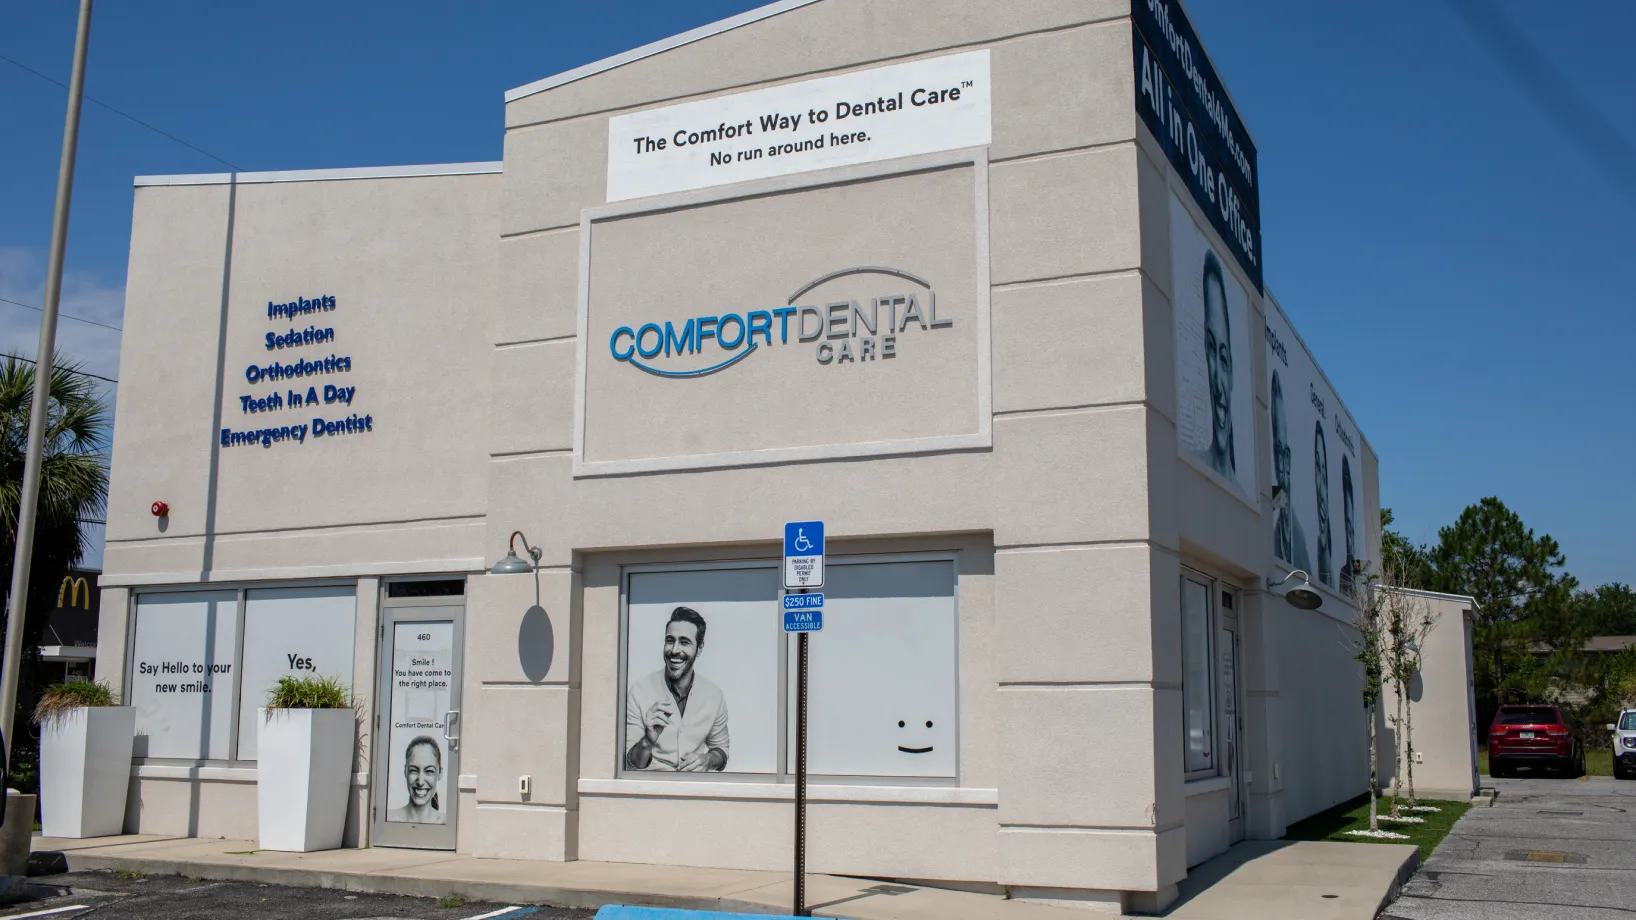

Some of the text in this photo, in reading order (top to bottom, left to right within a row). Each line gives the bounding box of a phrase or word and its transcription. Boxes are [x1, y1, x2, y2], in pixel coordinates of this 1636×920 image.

[633, 136, 667, 154] The
[673, 119, 753, 147] Comfort
[759, 111, 801, 134] Way
[808, 108, 829, 124] to
[836, 92, 903, 120] Dental
[710, 129, 871, 167] No run around here.
[1141, 45, 1257, 266] All in One Office.
[267, 294, 336, 319] Implants
[265, 325, 334, 349] Sedation
[816, 334, 896, 363] CARE
[245, 353, 351, 381] Orthodontics
[239, 384, 355, 412] Teeth In A Day
[220, 413, 373, 445] Emergency Dentist
[785, 596, 822, 608] $250 FINE
[785, 621, 821, 630] ACCESSIBLE
[794, 612, 812, 622] VAN
[417, 633, 431, 641] 460
[139, 661, 231, 677] Say Hello to your
[287, 653, 317, 672] Yes,
[411, 658, 430, 666] Smile
[395, 669, 407, 677] You
[408, 669, 423, 677] have
[444, 669, 451, 677] to
[155, 680, 212, 693] new smile.
[411, 680, 427, 689] right
[428, 680, 448, 689] place.
